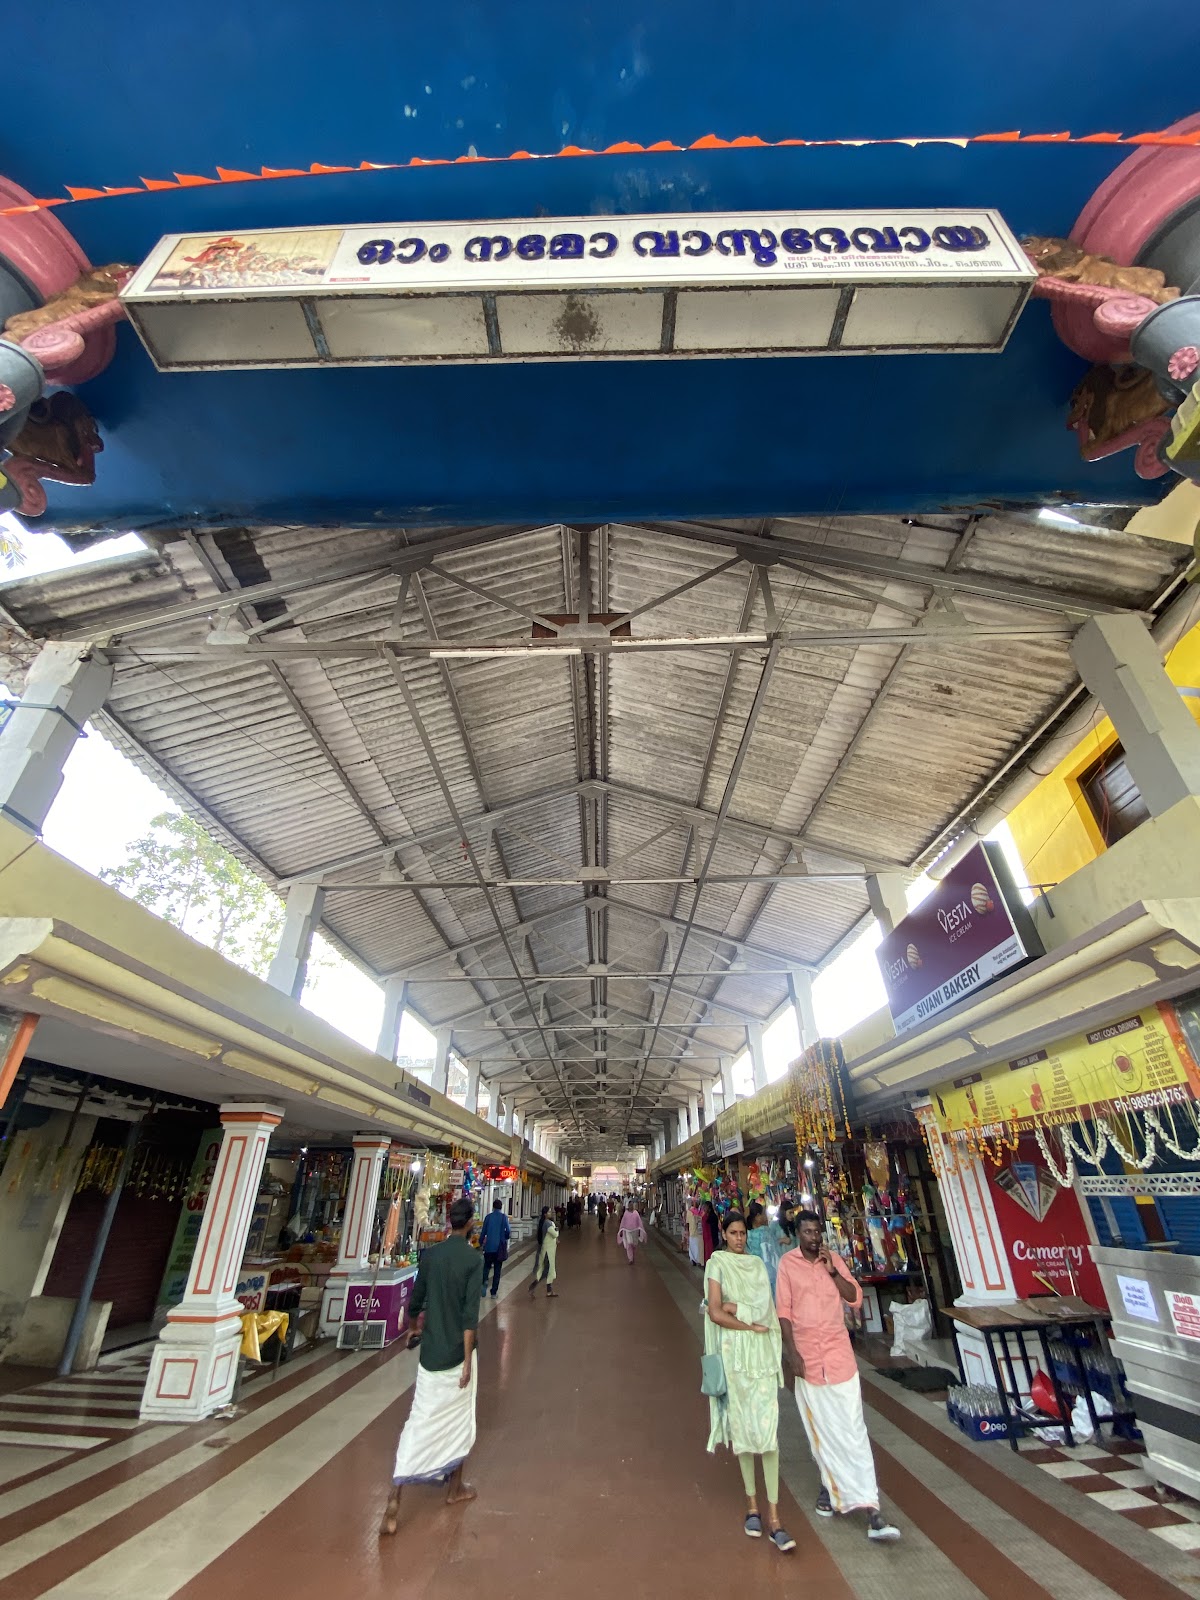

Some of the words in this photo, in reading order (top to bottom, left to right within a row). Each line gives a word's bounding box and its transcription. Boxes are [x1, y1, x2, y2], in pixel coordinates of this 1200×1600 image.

[356, 237, 452, 265] ഓം
[464, 231, 620, 263] നമോ
[632, 225, 991, 267] വാസുദേവായ
[784, 261, 808, 269] ശ്രീ
[937, 901, 973, 934] VESTA
[949, 935, 958, 944] ICE
[956, 922, 973, 938] CREAM
[916, 990, 944, 1018] SIVANI
[943, 963, 981, 1001] BAKERY
[1118, 1019, 1139, 1033] DRINKS
[1007, 1119, 1034, 1132] FUITS
[1034, 1117, 1043, 1128] &
[1032, 1269, 1059, 1279] Natually
[990, 1422, 1008, 1433] pep
